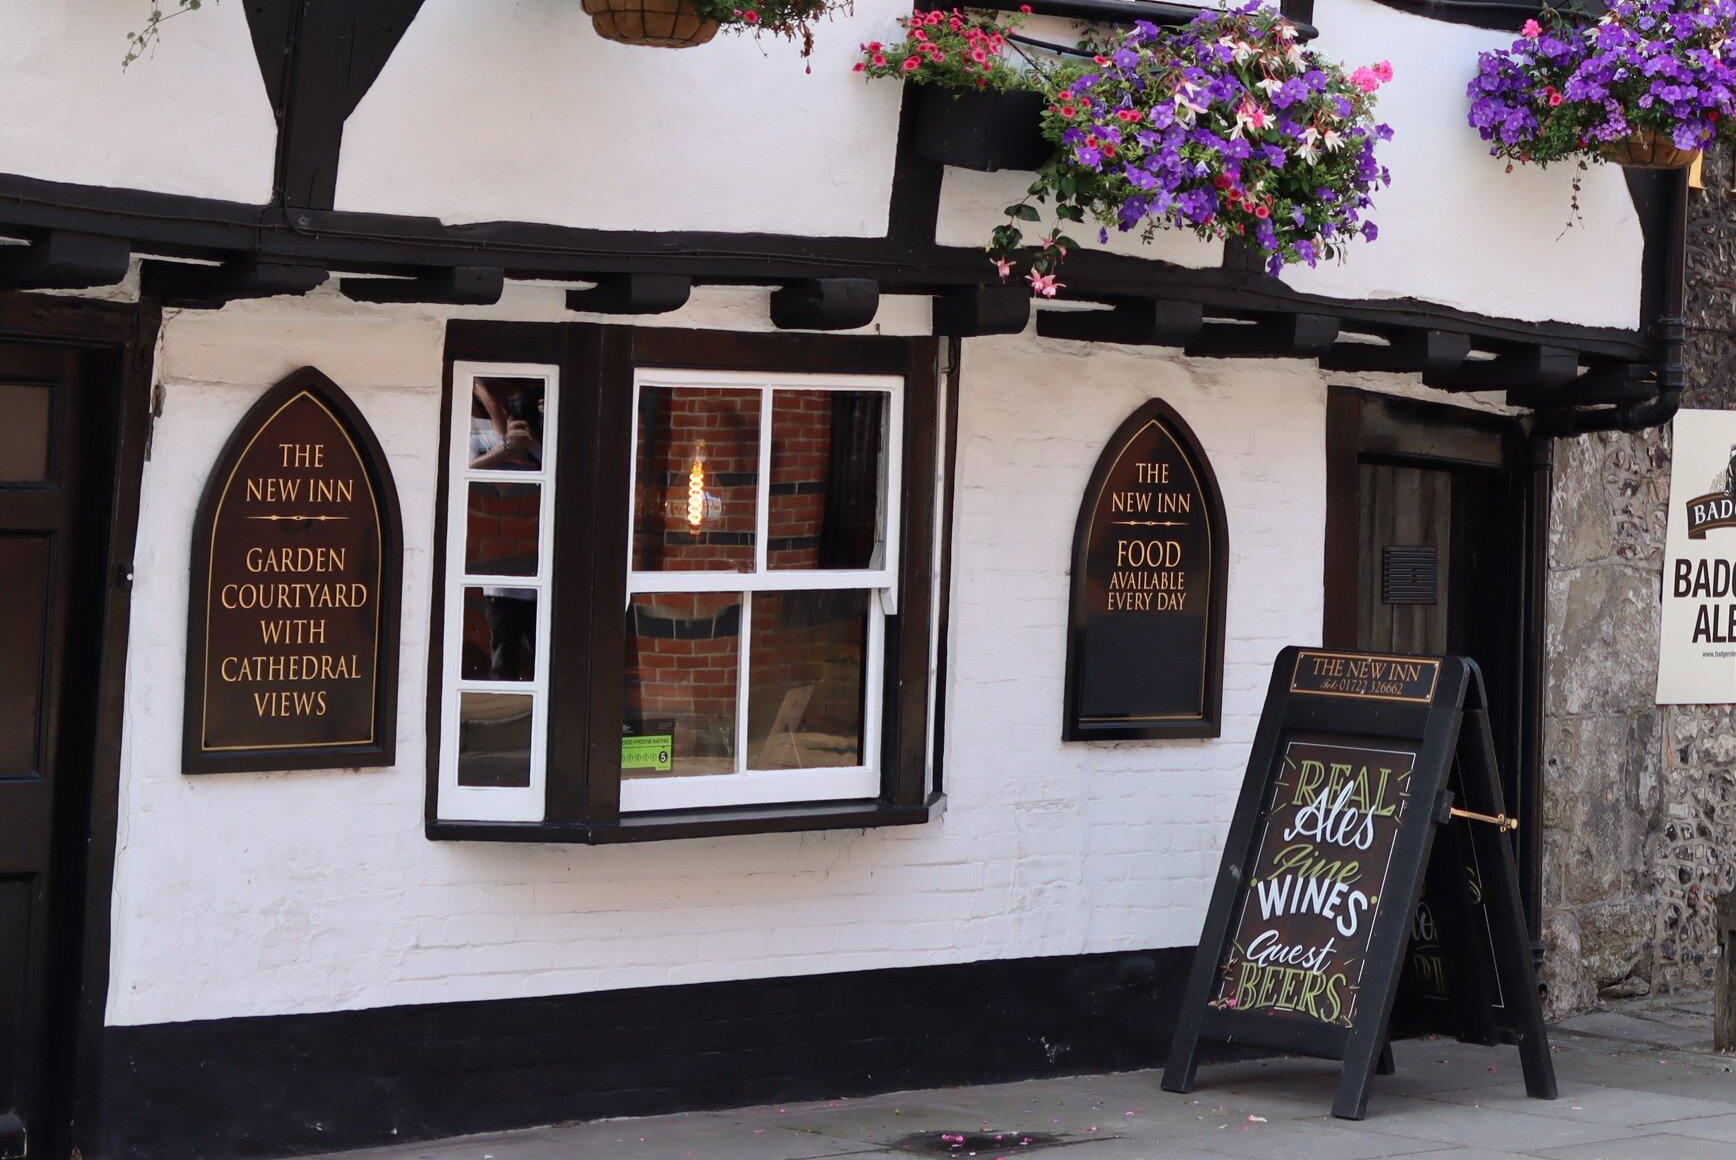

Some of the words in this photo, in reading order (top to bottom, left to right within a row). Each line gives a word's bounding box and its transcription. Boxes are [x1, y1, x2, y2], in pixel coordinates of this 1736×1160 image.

[279, 443, 324, 468] THE
[1135, 463, 1169, 484] THE
[246, 478, 301, 503] NEW
[309, 478, 354, 502] INN
[1112, 492, 1152, 513] NEW
[1157, 493, 1191, 513] INN
[246, 547, 346, 573] GARDEN
[1117, 540, 1181, 568] FOOD
[1109, 572, 1185, 590] AVAILABLE
[221, 583, 367, 609] COURTYARD
[1107, 592, 1156, 611] EVERY
[1157, 592, 1188, 611] DAY
[260, 619, 326, 645] WITH
[221, 654, 362, 682] CATHEDRAL
[1312, 658, 1345, 676] THE
[1348, 660, 1387, 680] NEW
[1389, 663, 1421, 682] INN
[253, 691, 327, 717] VIEWS
[1292, 760, 1397, 816] REAL
[1284, 780, 1376, 850] Ales
[1266, 844, 1362, 885] Fine
[1257, 874, 1368, 937] WINES
[1246, 929, 1338, 975] Guest
[1236, 962, 1347, 1023] BEERS
